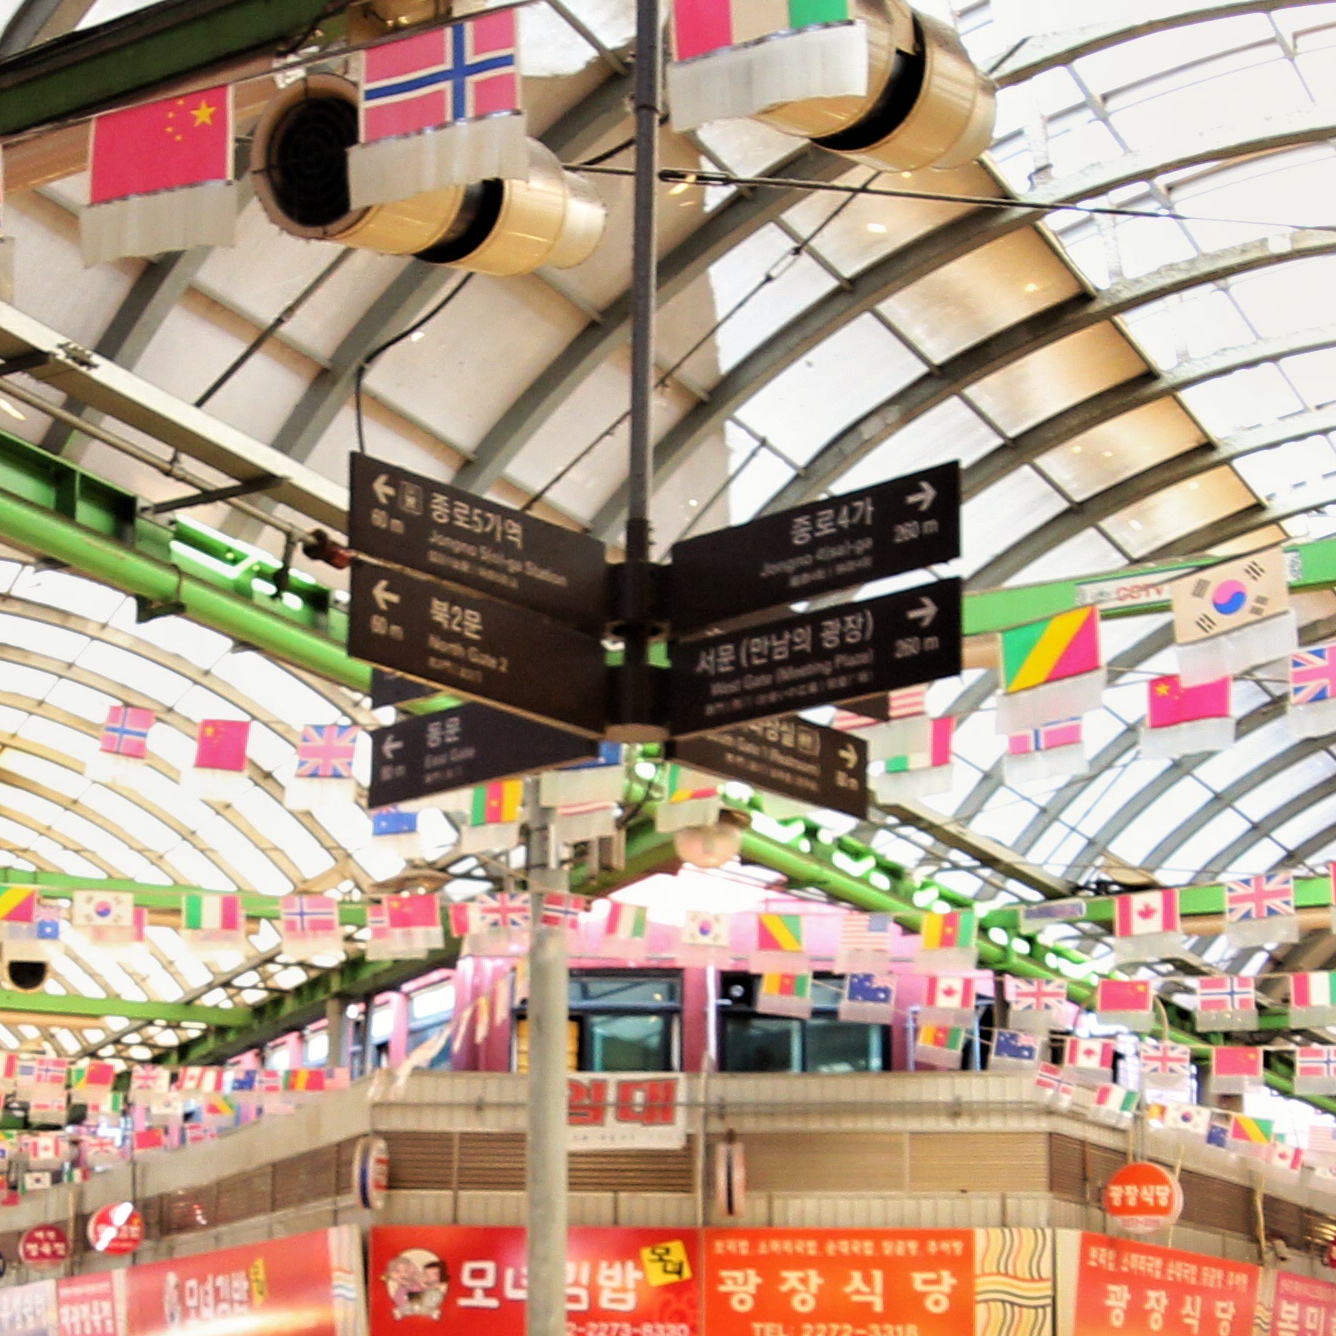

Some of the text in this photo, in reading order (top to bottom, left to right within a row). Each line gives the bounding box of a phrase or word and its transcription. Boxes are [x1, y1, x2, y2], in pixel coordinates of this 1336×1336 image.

[429, 491, 523, 549] 종로5가역
[790, 496, 874, 545] 종로4가
[430, 597, 483, 641] 북2문
[818, 608, 874, 649] 광장)
[1109, 1184, 1170, 1207] 광장식당
[718, 1268, 958, 1315] 광장식당
